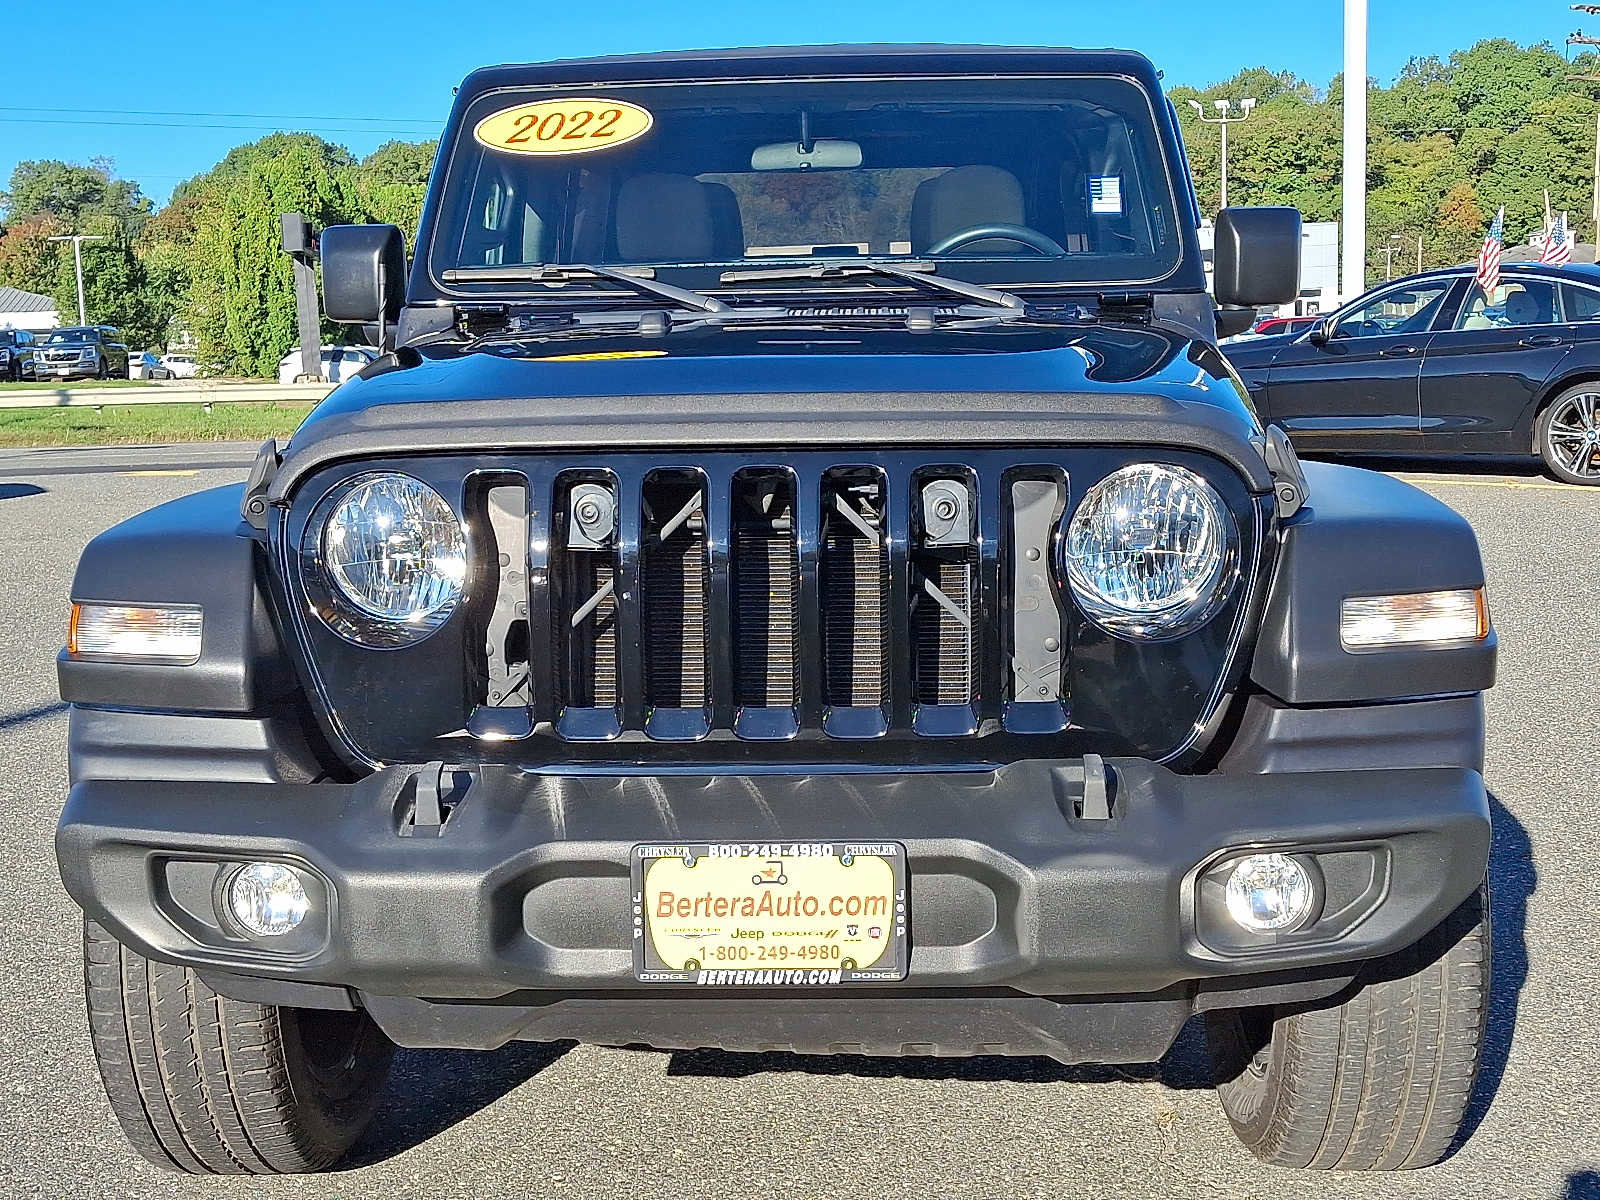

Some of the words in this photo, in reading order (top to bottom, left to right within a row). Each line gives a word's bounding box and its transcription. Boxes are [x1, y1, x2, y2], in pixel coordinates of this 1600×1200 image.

[504, 109, 623, 144] 2022
[638, 846, 690, 857] CHRYSLER
[844, 845, 897, 856] CHRYSLER
[656, 890, 888, 918] BerteraAuto.com
[632, 891, 643, 939] Jeep
[895, 889, 906, 937] Jeep
[730, 928, 765, 941] Jeep
[699, 945, 840, 961] 1-800-249-4980
[696, 969, 843, 985] BERTERAAUTO.COM
